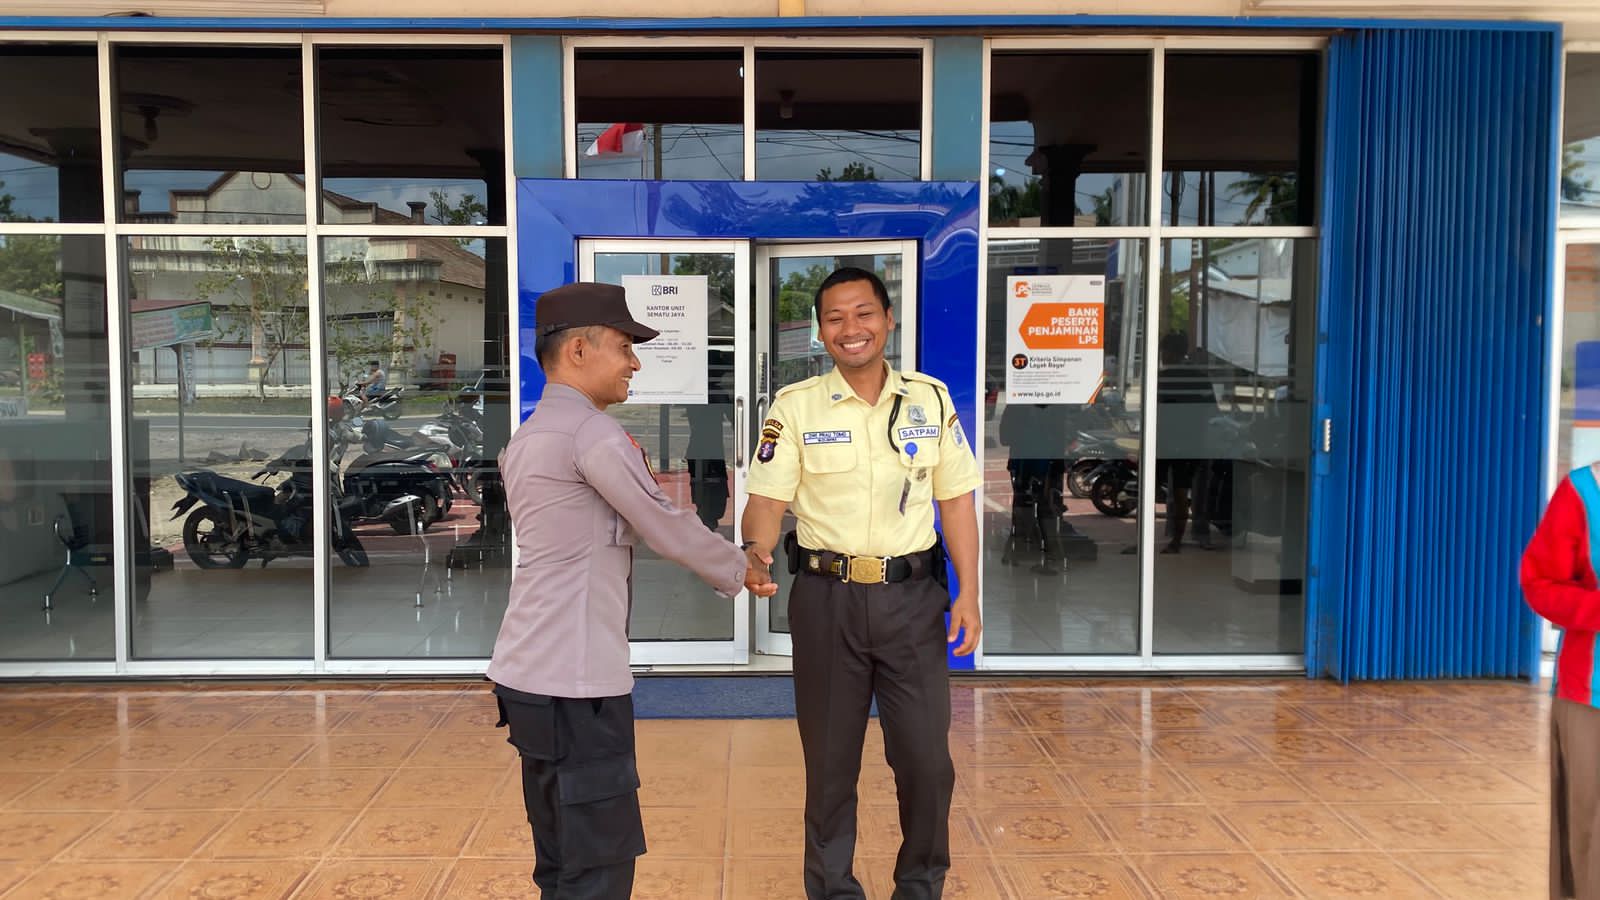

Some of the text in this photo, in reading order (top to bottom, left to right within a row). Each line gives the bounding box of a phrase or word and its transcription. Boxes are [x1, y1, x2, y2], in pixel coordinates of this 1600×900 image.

[663, 286, 678, 295] BRI
[1068, 308, 1099, 316] BANK
[1051, 317, 1098, 326] PESERTA
[1028, 326, 1098, 336] PENJAMINAN
[1078, 335, 1098, 344] LPS
[1014, 357, 1026, 366] 3T
[902, 428, 937, 438] SATPAM
